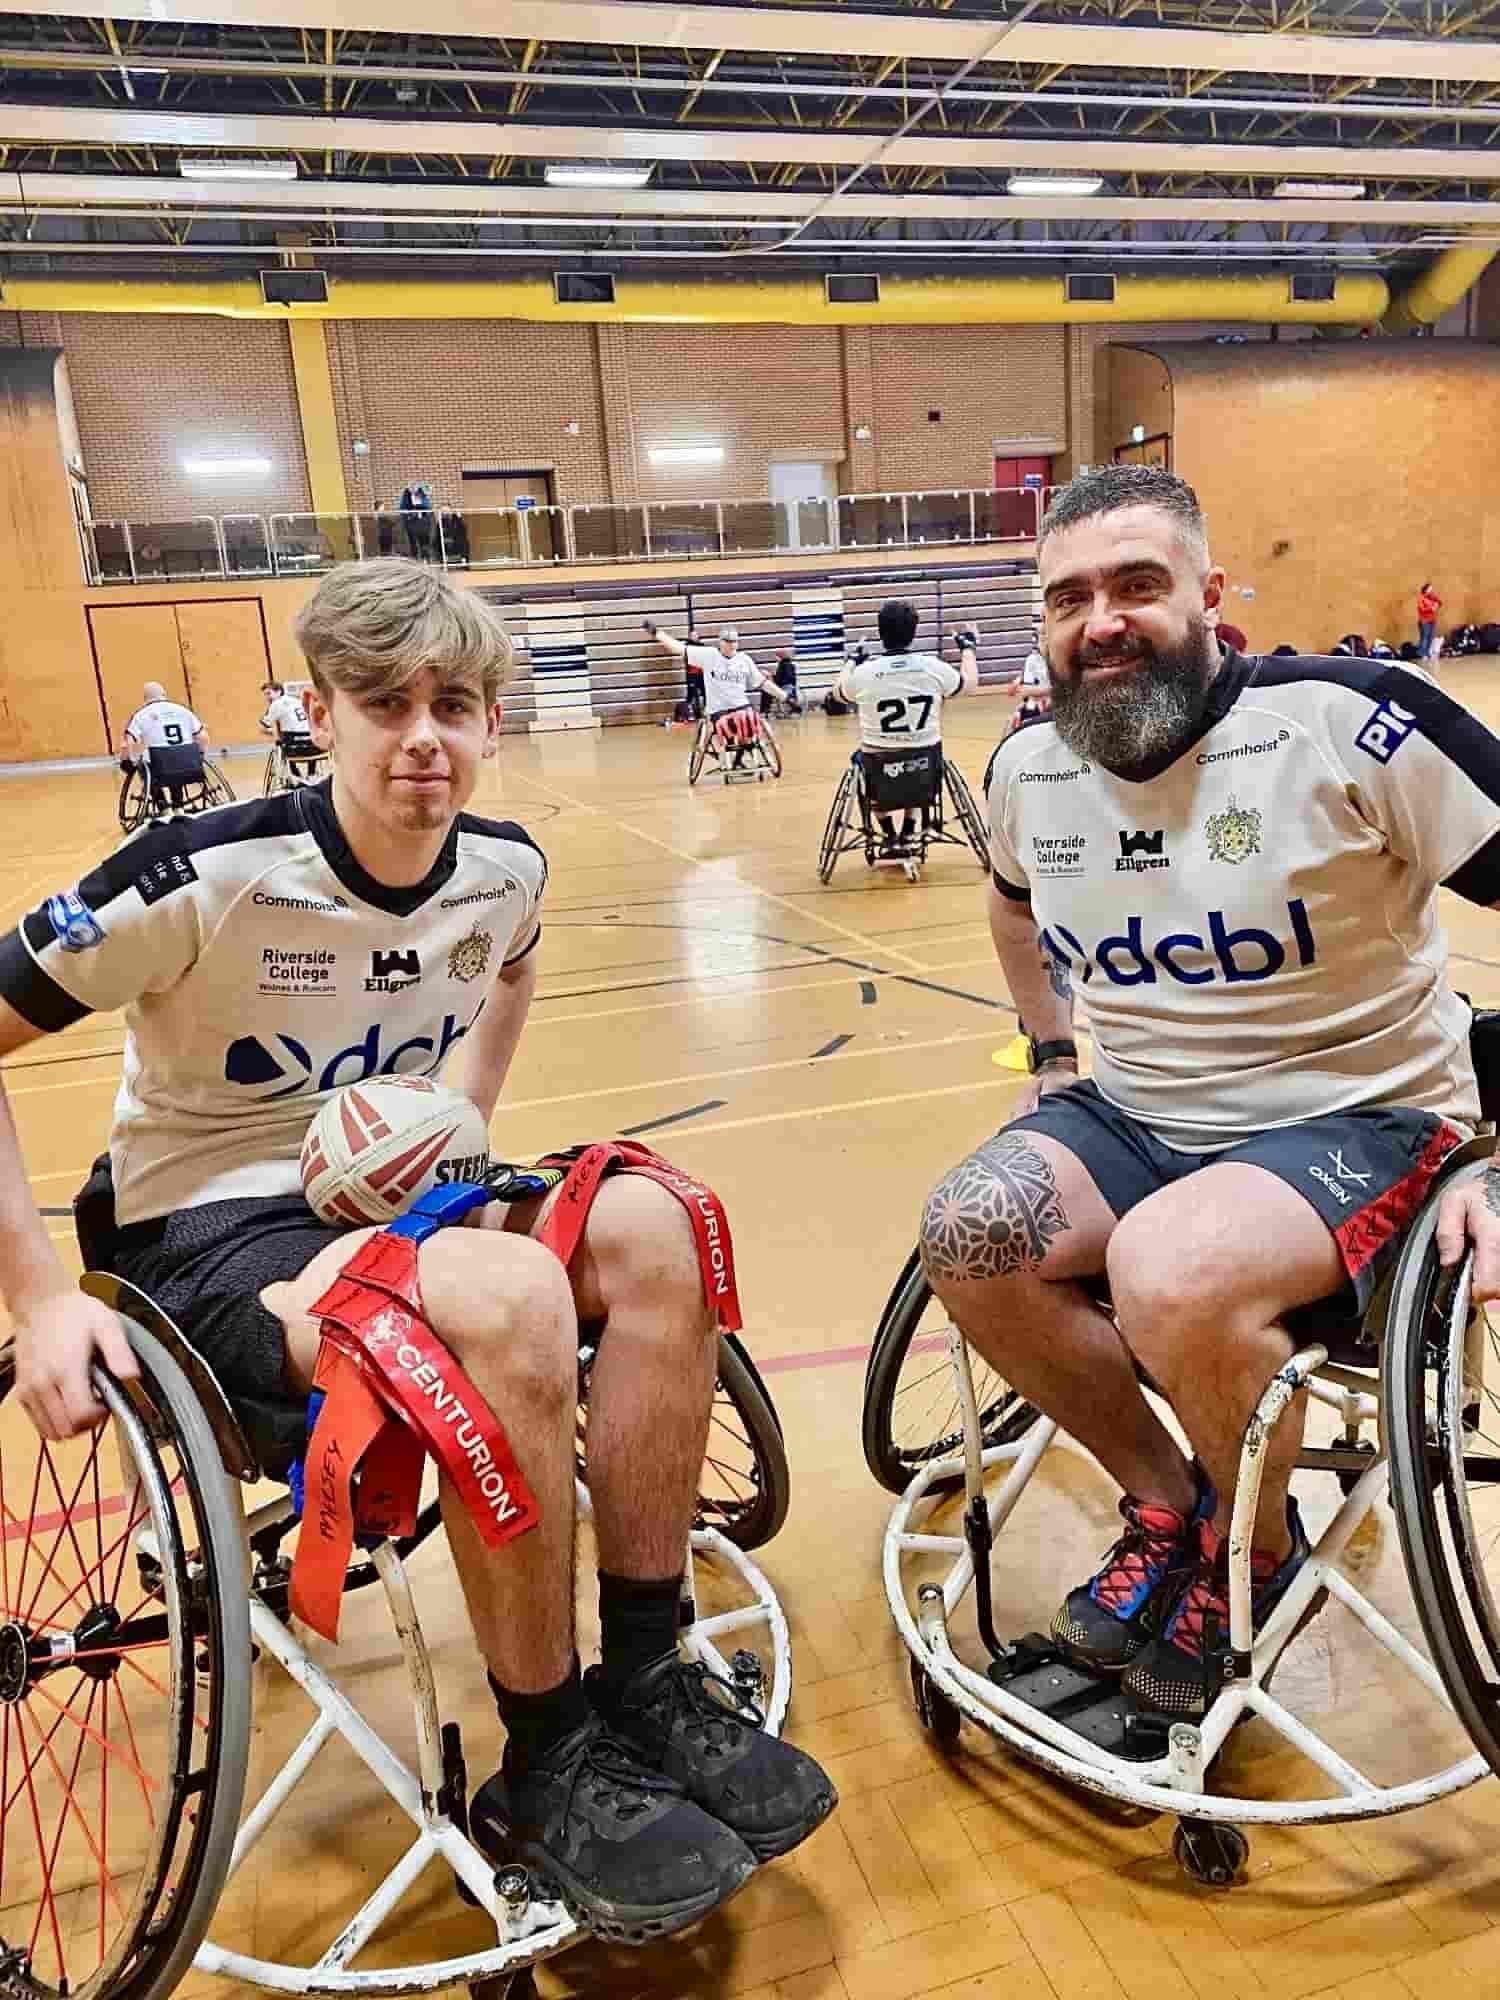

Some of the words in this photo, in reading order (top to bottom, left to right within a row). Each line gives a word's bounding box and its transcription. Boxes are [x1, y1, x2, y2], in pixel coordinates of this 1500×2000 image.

[877, 695, 934, 733] 27
[164, 724, 184, 745] 9
[1196, 739, 1279, 766] Commhoist
[1019, 769, 1080, 784] Commhoist
[1036, 849, 1081, 865] College
[1115, 857, 1170, 873] Ellgren
[252, 891, 338, 913] Commhoist
[440, 888, 507, 910] Commhoist
[1095, 898, 1317, 986] dcbl
[262, 948, 337, 965] Riverside
[268, 965, 330, 984] College
[1308, 1164, 1352, 1206] OXEN
[396, 1343, 518, 1524] CENTURION
